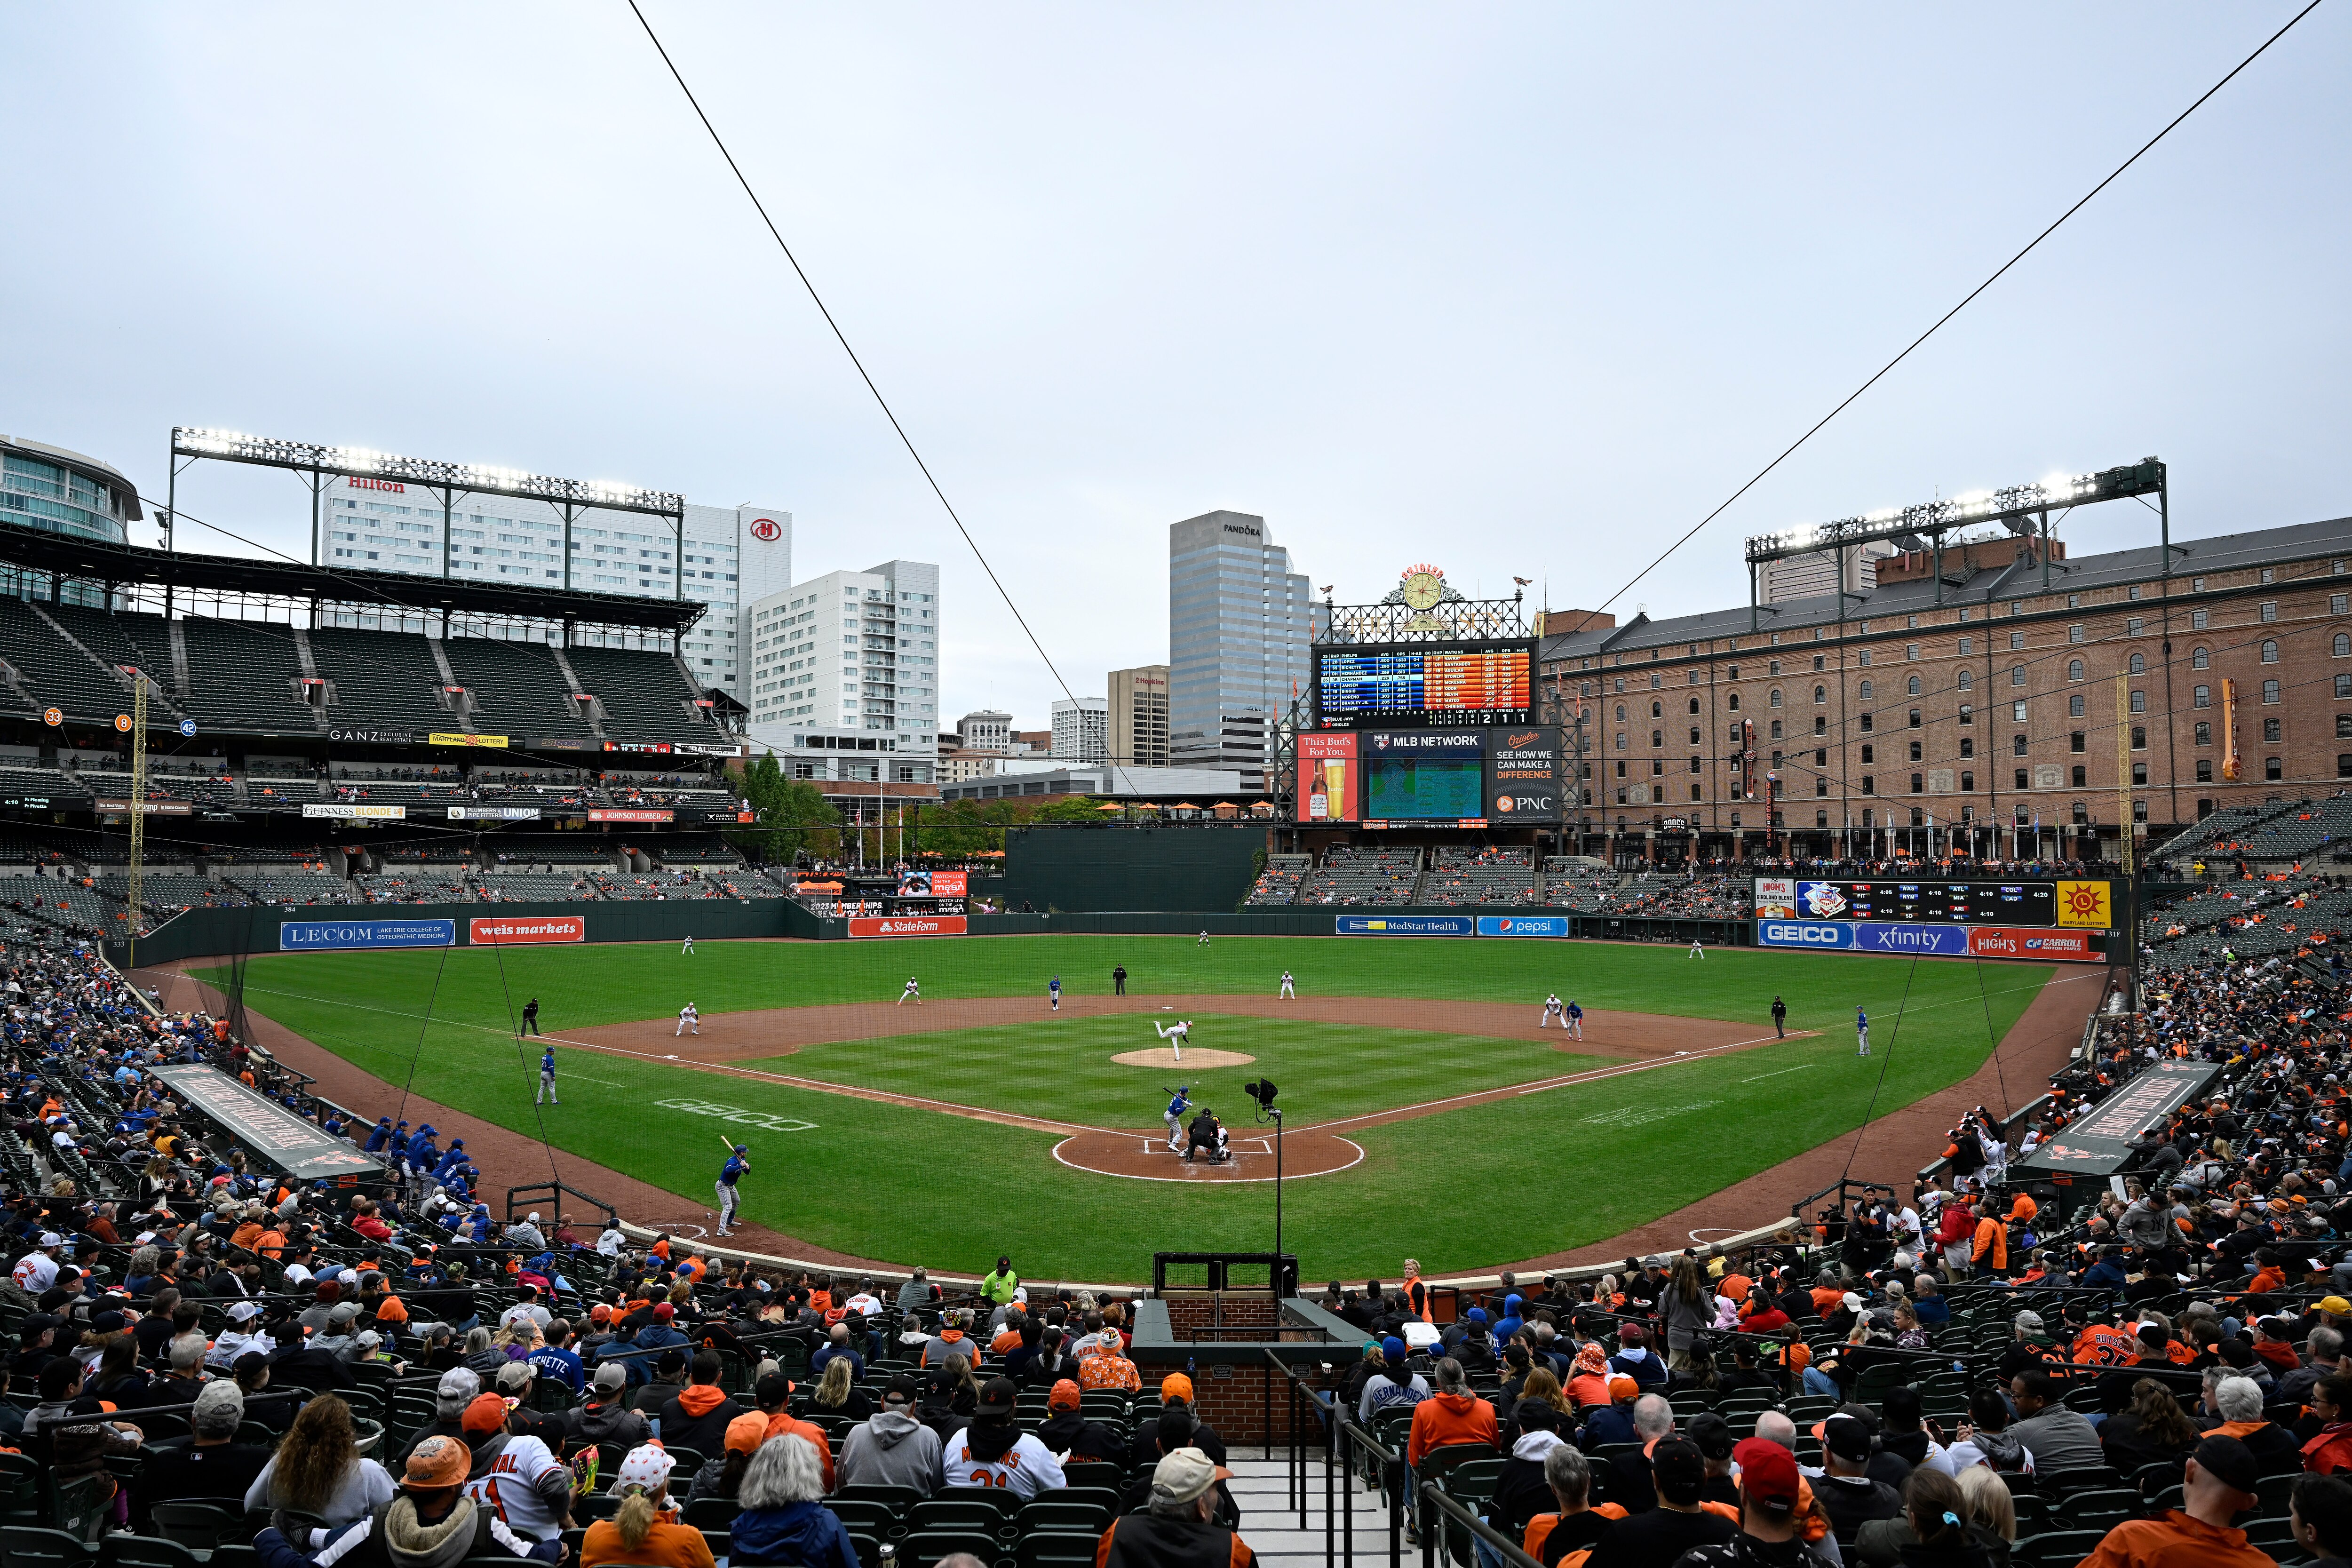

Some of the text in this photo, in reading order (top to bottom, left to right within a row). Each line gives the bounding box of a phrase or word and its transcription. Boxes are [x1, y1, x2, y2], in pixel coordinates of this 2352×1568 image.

[349, 476, 405, 493] Hilton
[1224, 525, 1260, 536] PANDORA
[1784, 551, 1829, 563] TRANSAMERICA
[1402, 564, 1444, 579] ORIOLES
[1346, 612, 1502, 634] THE SUN
[48, 712, 60, 722] 33
[121, 719, 127, 727] 8
[183, 724, 194, 732] 42
[330, 730, 378, 741] GANZ
[1394, 736, 1478, 747] MLB NETWORK
[1508, 732, 1539, 749] Orioles
[1516, 797, 1552, 810] PNC
[305, 805, 391, 816] GUINNESS BLONDE
[504, 809, 539, 817] UNION
[1763, 883, 1785, 892] HIGH'S
[479, 923, 576, 935] weis markets
[1517, 921, 1551, 932] pepsi
[1768, 925, 1838, 942] GEICO
[1878, 927, 1941, 950] xfinity
[1979, 938, 2016, 953] HIGH'S
[2043, 939, 2082, 947] CARROLL
[185, 1077, 320, 1148] WELCOME TO ORIOLE PARK
[2085, 1079, 2183, 1136] HOME OF THE ORIOLES
[653, 1098, 821, 1131] GEICO
[529, 1356, 569, 1373] BICHETTE
[1373, 1385, 1425, 1404] HERNANDEZ
